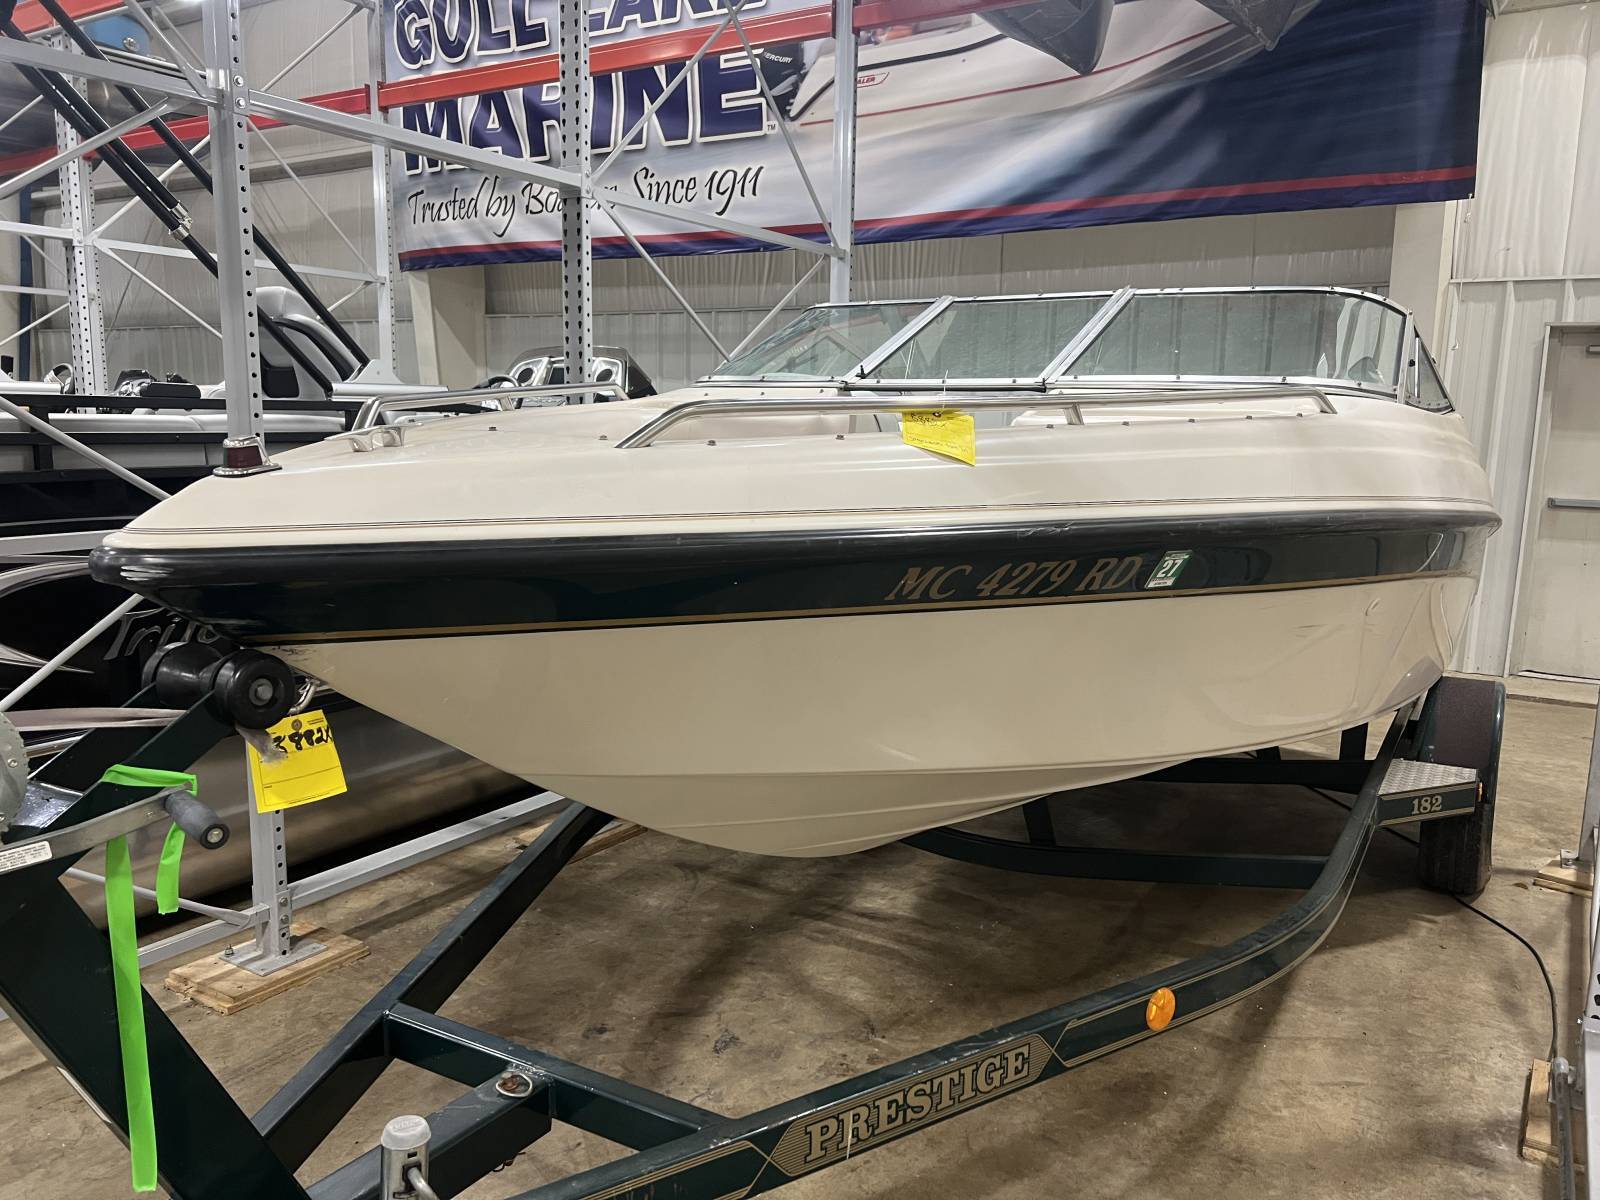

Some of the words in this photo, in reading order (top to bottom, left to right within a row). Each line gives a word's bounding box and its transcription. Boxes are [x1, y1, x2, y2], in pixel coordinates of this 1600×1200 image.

[393, 0, 549, 69] GULL
[400, 47, 767, 175] MARINE
[407, 177, 480, 225] Trusted
[486, 176, 516, 237] by
[633, 167, 698, 204] Since
[704, 165, 765, 216] 1911
[885, 564, 973, 600] MC
[976, 559, 1077, 598] 4279
[1074, 556, 1143, 592] RD
[1156, 559, 1184, 578] 27
[1411, 794, 1442, 815] 182
[804, 1043, 1031, 1164] PRESTIGE
